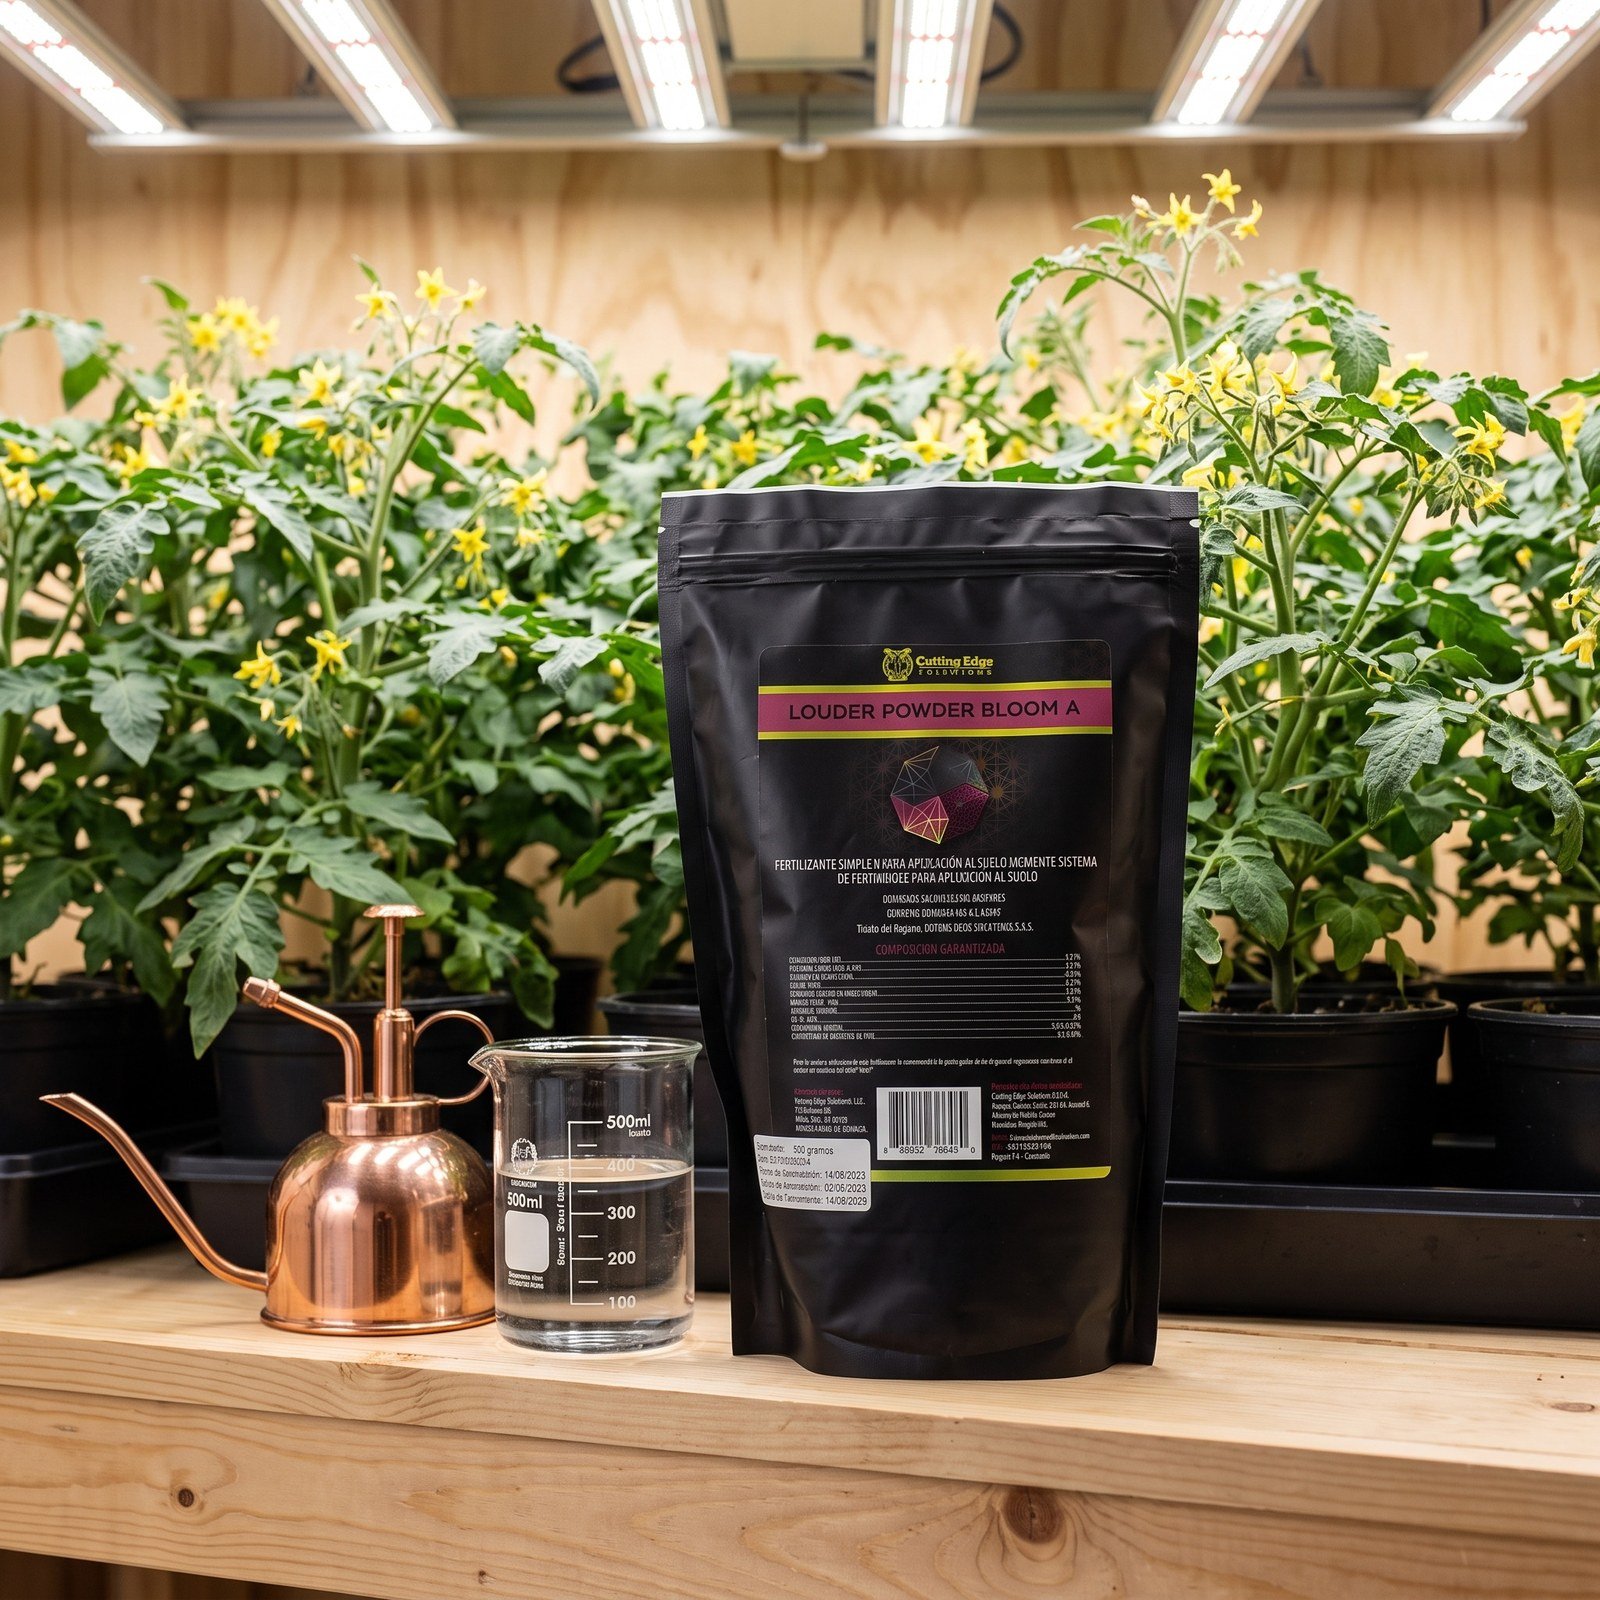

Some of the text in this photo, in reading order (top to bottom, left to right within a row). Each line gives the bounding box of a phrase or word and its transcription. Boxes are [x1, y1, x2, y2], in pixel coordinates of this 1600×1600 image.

[916, 656, 994, 668] Cutting Edge
[789, 699, 1080, 720] LOUDER POWDER BLOOM A
[775, 858, 837, 871] FERTILIZANTE
[838, 858, 872, 870] SIMPLE
[1058, 855, 1098, 868] SISTEMA
[837, 872, 850, 884] DE
[994, 872, 1006, 882] AL
[1007, 871, 1038, 882] SUOLO
[940, 943, 1006, 955] GARANTIZADA
[606, 1113, 651, 1129] 500ml
[793, 1145, 805, 1154] 500
[806, 1146, 834, 1156] gramos
[607, 1157, 636, 1172] 400
[507, 1191, 543, 1209] 500ml
[607, 1205, 636, 1220] 300
[607, 1250, 636, 1266] 200
[608, 1295, 637, 1310] 100
